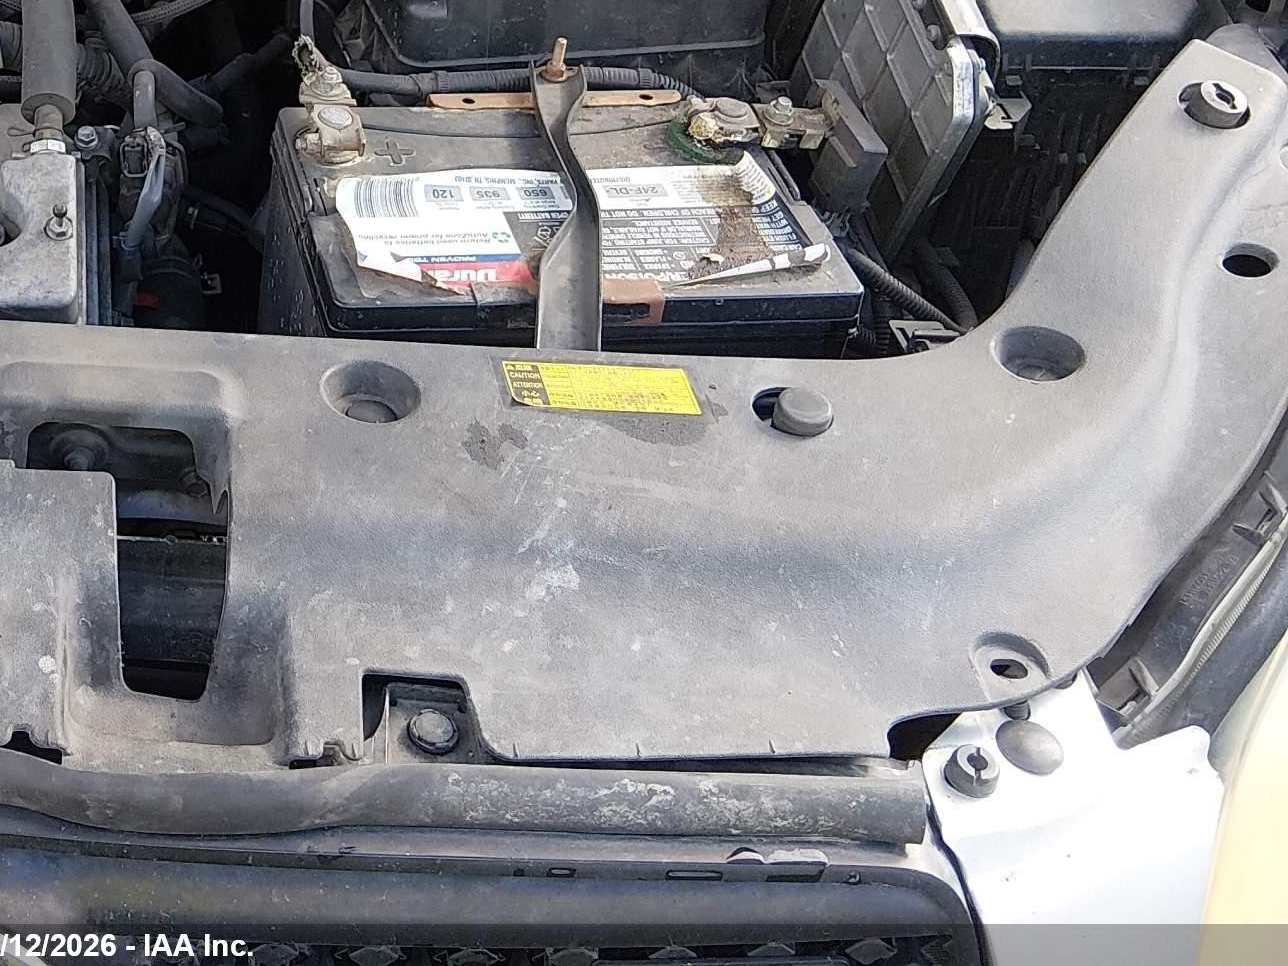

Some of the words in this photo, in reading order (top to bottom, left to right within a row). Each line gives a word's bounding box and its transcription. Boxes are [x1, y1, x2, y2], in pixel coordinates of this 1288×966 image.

[431, 189, 454, 199] 120
[476, 190, 501, 198] 935
[523, 189, 548, 197] 650
[760, 199, 779, 213] KEEP
[604, 271, 689, 282] ER/POISON
[509, 371, 541, 379] CAUTION
[512, 381, 544, 389] ATTENTION
